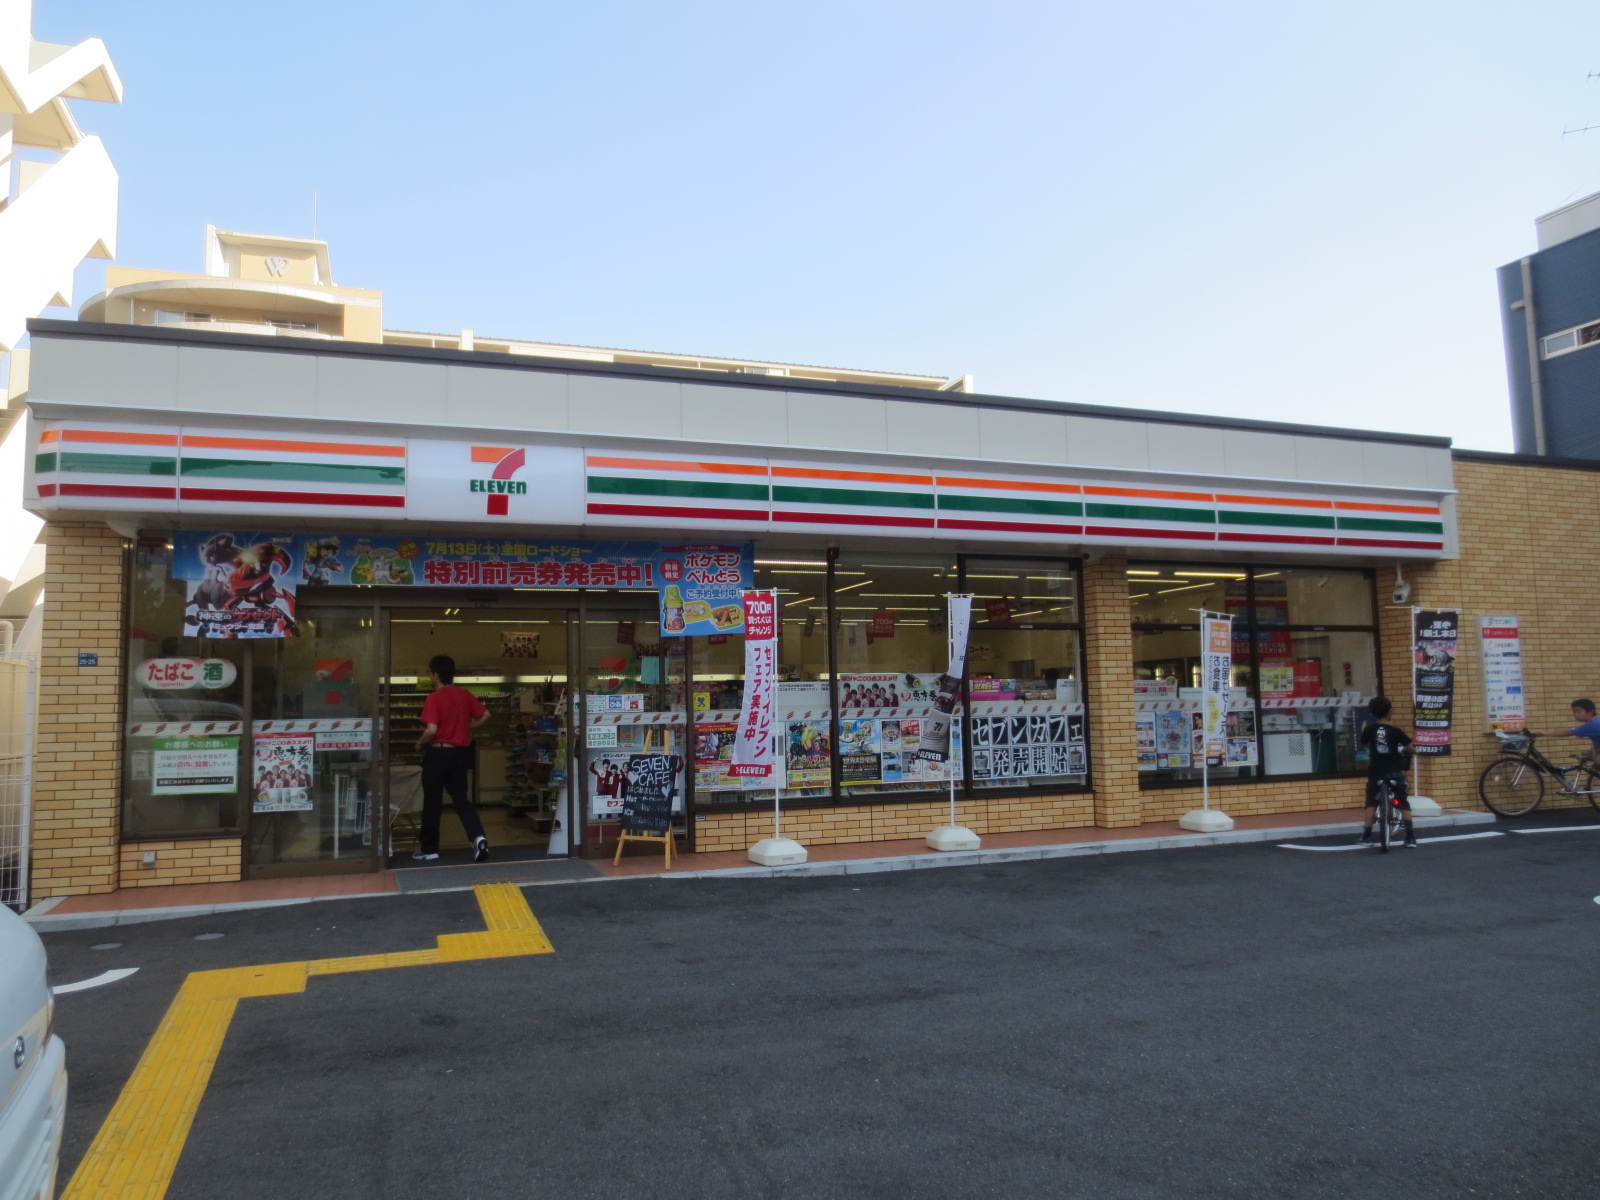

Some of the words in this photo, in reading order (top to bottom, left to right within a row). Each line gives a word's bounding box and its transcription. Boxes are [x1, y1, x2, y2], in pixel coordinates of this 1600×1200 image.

[471, 446, 526, 515] 7
[685, 552, 741, 568] ポケモン
[423, 559, 654, 587] 特別前売券発売中!
[686, 569, 741, 585] べんとう
[746, 600, 772, 614] 700円
[148, 662, 195, 681] たばこ
[203, 662, 223, 681] 酒
[972, 716, 1083, 746] セブンカフェ
[631, 756, 671, 775] SEVEN
[993, 746, 1067, 776] 発売開始
